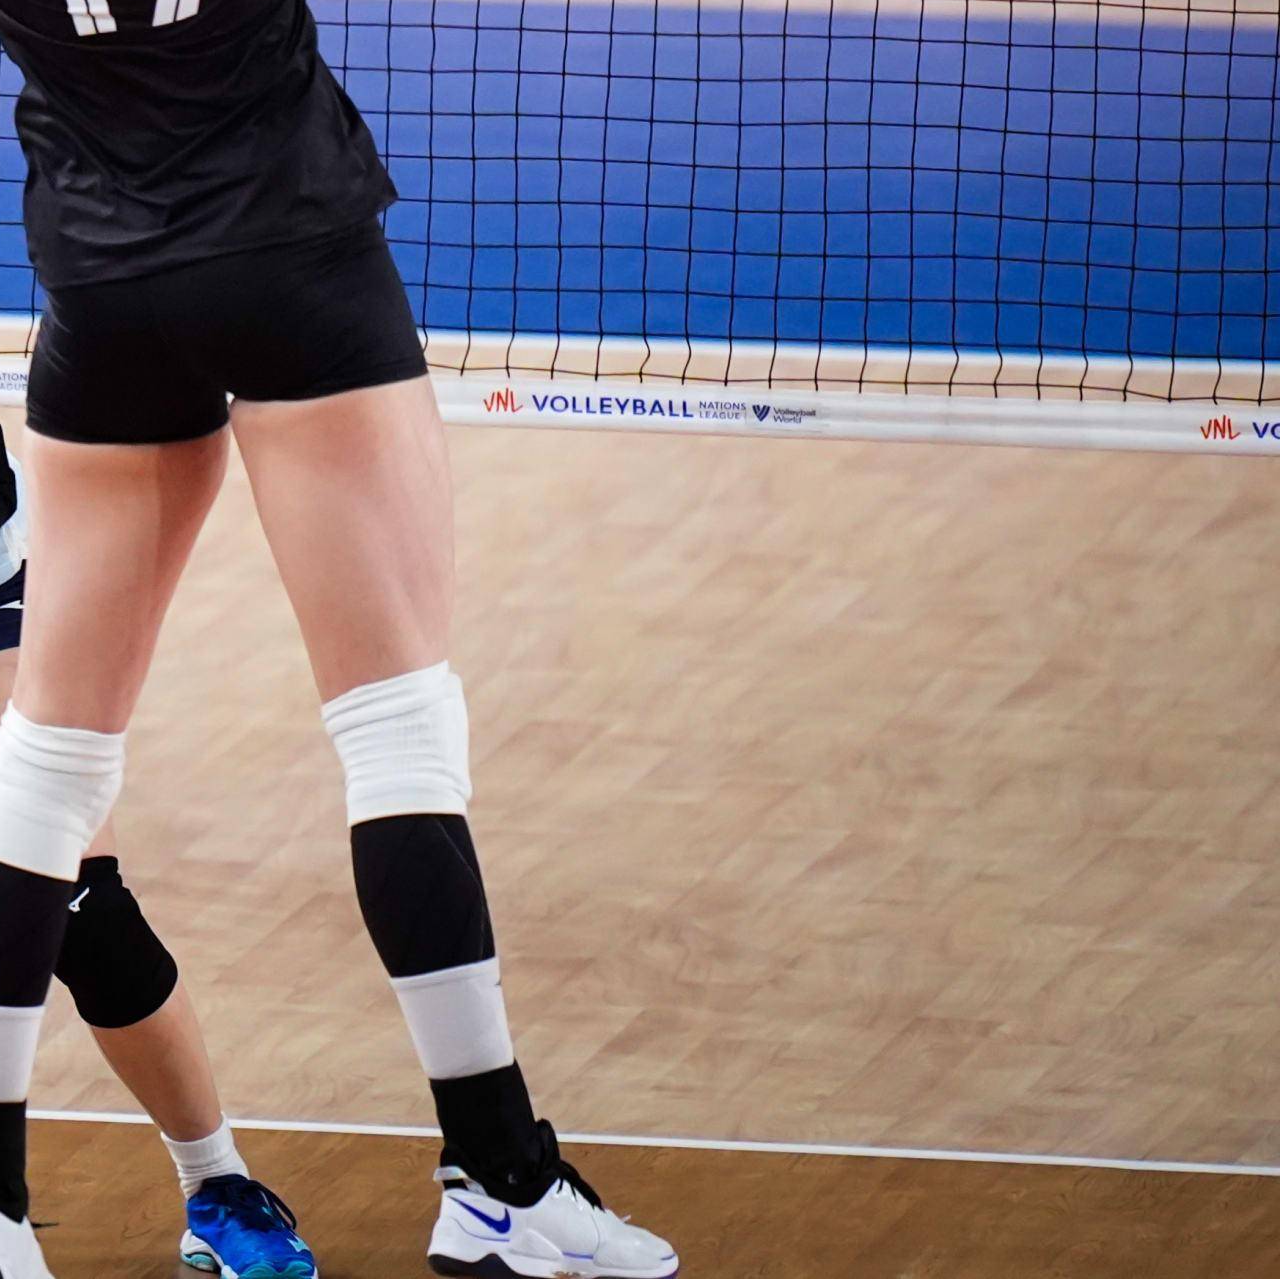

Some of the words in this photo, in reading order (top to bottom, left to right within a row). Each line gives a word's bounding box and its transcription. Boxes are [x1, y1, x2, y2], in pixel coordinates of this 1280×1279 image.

[484, 388, 523, 413] VNL
[532, 394, 694, 418] VOLLEYBALL
[699, 401, 746, 411] NATIONS
[699, 411, 740, 420] LEAGUE
[1200, 415, 1241, 440] VNL
